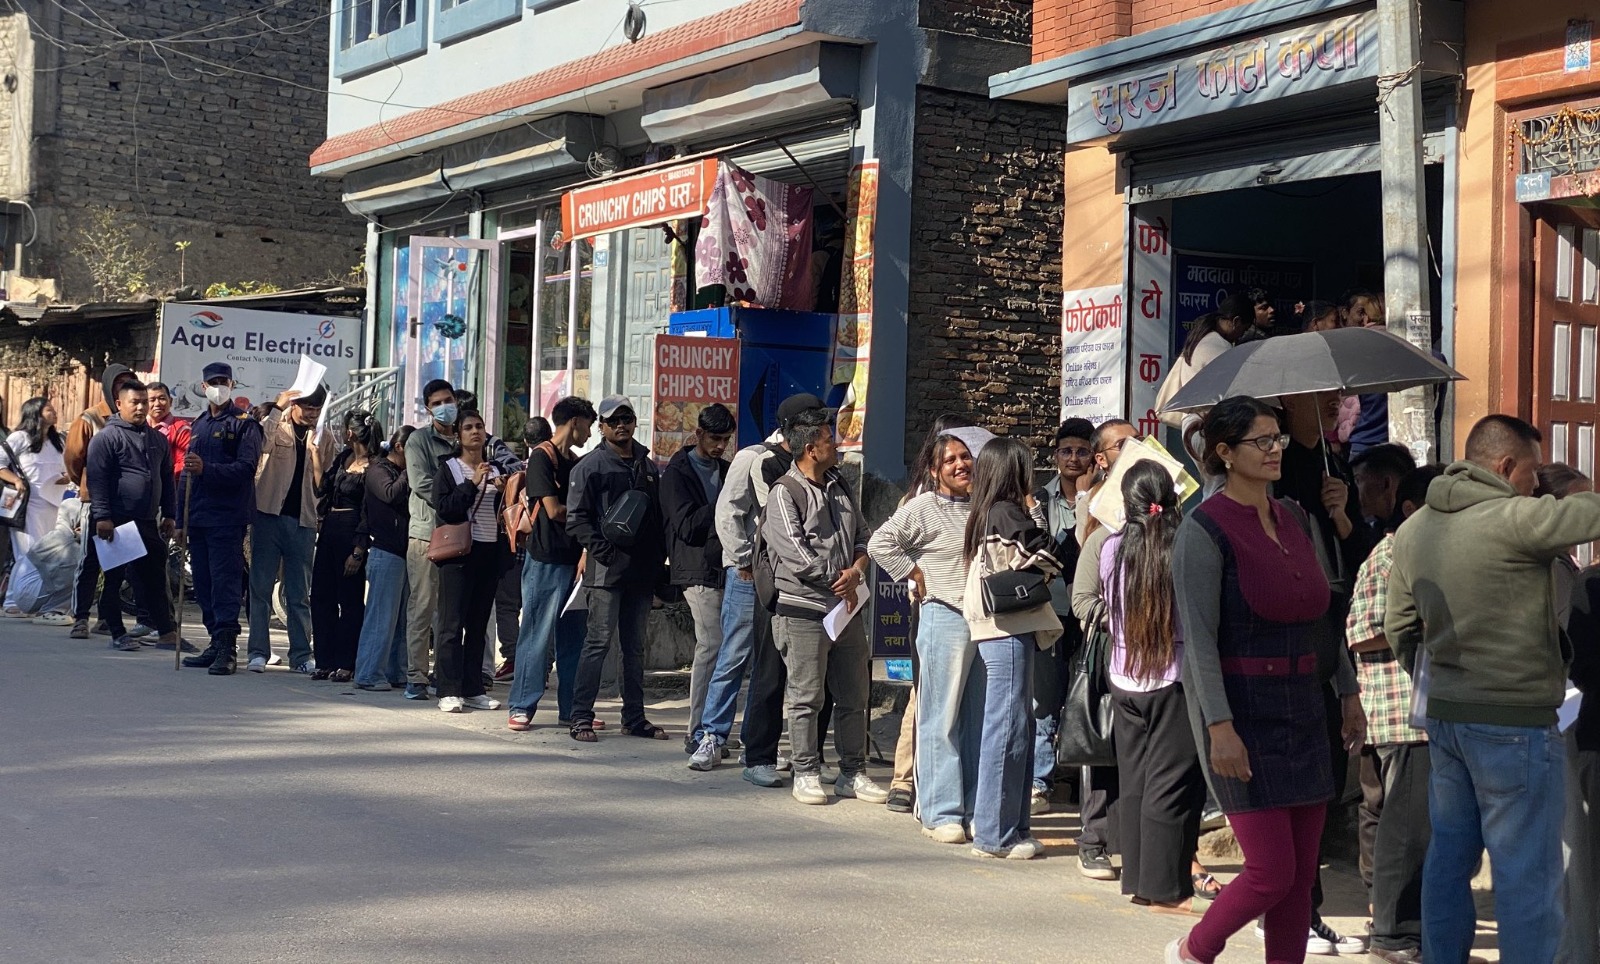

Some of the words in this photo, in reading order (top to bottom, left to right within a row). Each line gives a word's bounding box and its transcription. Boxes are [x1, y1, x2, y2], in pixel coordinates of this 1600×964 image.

[1091, 65, 1179, 134] सुरज
[578, 193, 630, 228] CRUNCHY
[633, 186, 666, 217] CHIPS
[1187, 265, 1235, 284] मतदाता
[1178, 292, 1211, 311] फारम
[1065, 294, 1122, 333] फोटोकपी
[170, 326, 235, 352] Aqua
[245, 332, 354, 358] Electricals
[226, 354, 251, 362] Contact
[253, 355, 264, 363] No:
[659, 344, 733, 370] CRUNCHY
[1065, 363, 1083, 373] Online
[658, 373, 704, 398] CHIPS
[1065, 396, 1084, 406] Online
[880, 611, 902, 626] साथै
[884, 636, 906, 647] तथा
